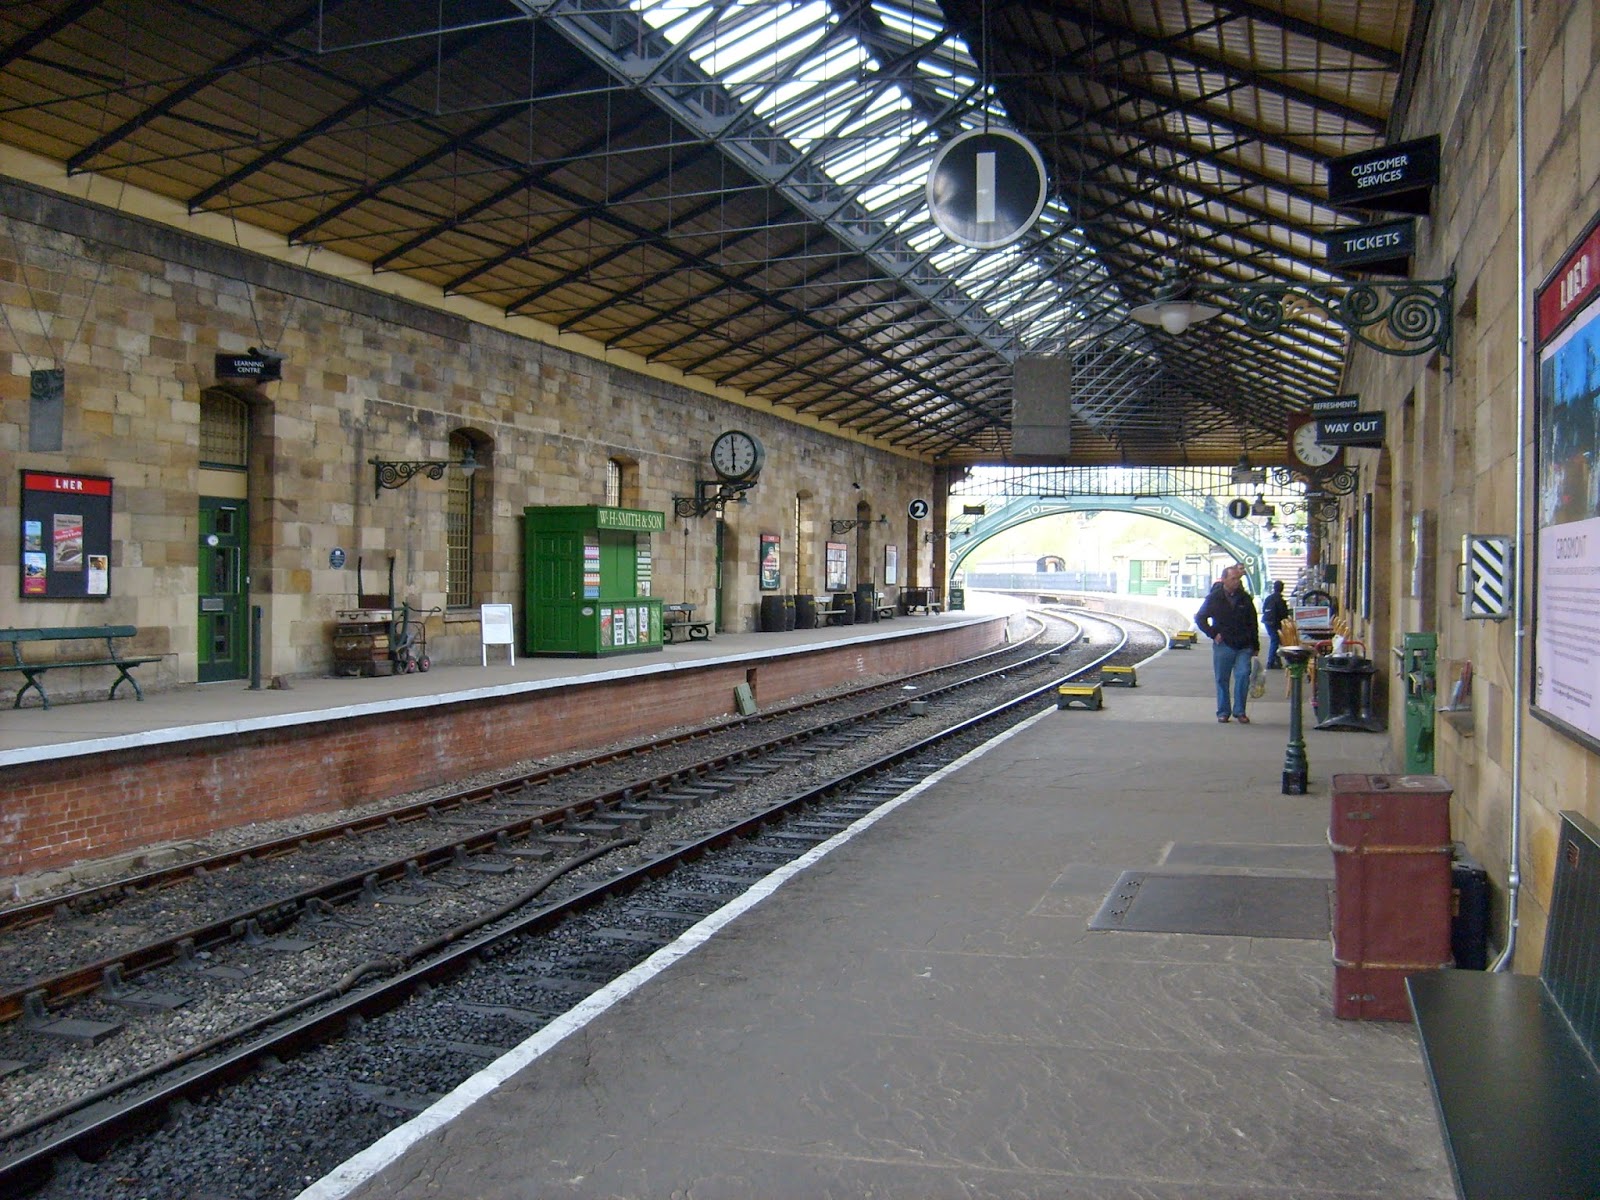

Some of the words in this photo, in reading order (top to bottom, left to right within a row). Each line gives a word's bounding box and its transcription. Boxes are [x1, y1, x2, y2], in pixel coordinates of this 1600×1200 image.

[1351, 155, 1408, 177] CUSTOMER
[1357, 169, 1402, 188] SERVICES
[1344, 232, 1400, 252] TICKETS
[234, 360, 265, 368] LEARNING
[1313, 400, 1357, 410] REFRESHMENTS
[1324, 423, 1350, 434] WAY
[1353, 421, 1378, 432] OUT
[55, 479, 83, 490] LNER
[914, 502, 925, 517] 2
[647, 515, 662, 529] SON
